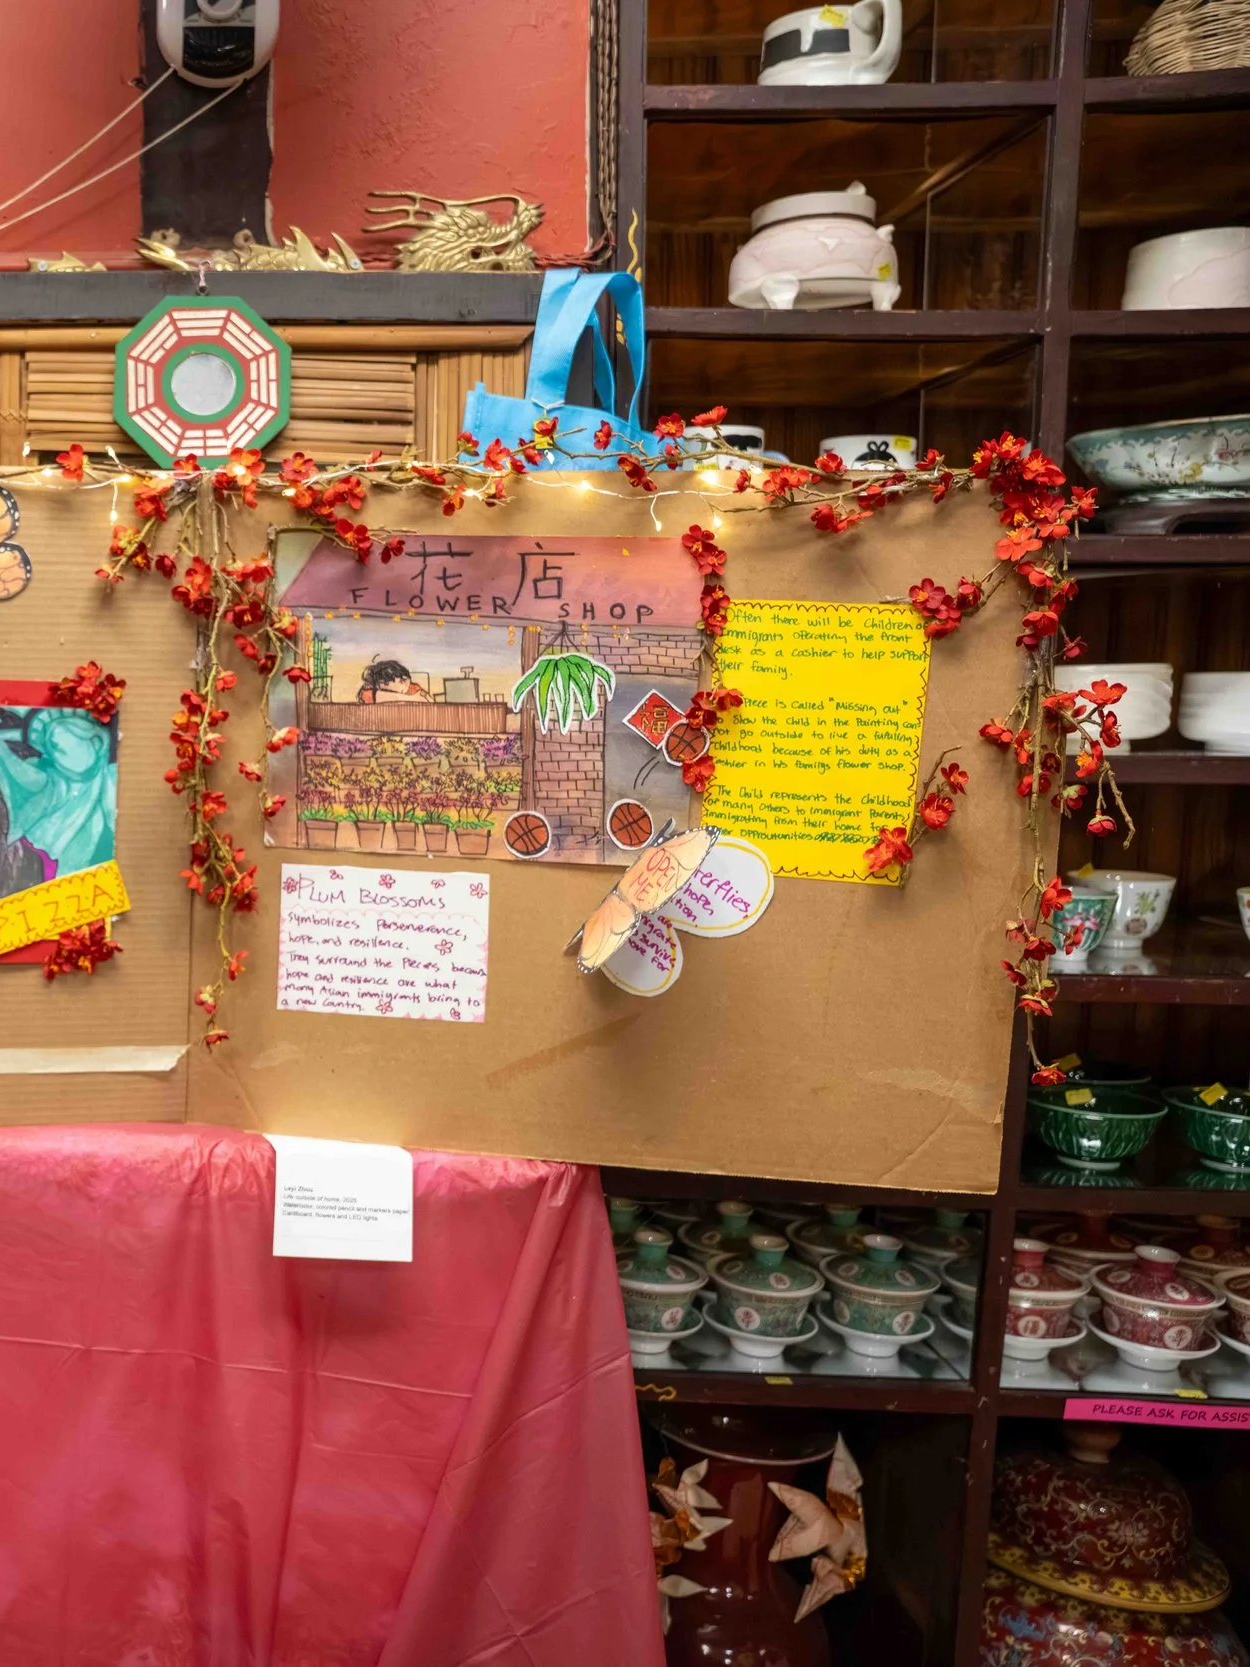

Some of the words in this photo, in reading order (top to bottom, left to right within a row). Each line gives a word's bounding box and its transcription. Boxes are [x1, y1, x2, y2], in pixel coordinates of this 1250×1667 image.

[405, 541, 580, 606] 花店
[349, 587, 514, 615] FLOWER
[558, 602, 654, 623] SHOP
[725, 607, 762, 623] Often
[807, 617, 830, 626] will
[838, 616, 852, 628] be
[855, 632, 874, 641] the
[843, 649, 854, 658] to
[862, 648, 885, 660] help
[775, 699, 786, 709] is
[762, 716, 777, 725] the
[834, 718, 849, 726] the
[740, 729, 754, 739] go
[812, 731, 824, 739] to
[772, 742, 812, 756] because
[820, 747, 831, 755] of
[835, 746, 850, 755] his
[859, 744, 880, 757] duty
[717, 785, 731, 796] The
[834, 793, 852, 804] the
[722, 800, 753, 814] many
[797, 806, 805, 815] to
[834, 820, 861, 831] home
[322, 937, 342, 947] and
[374, 957, 393, 968] the
[286, 968, 309, 980] hope
[315, 974, 333, 983] and
[398, 979, 416, 987] are
[425, 979, 456, 989] what
[468, 997, 480, 1006] to
[1093, 1404, 1143, 1416] PLEASE
[1148, 1408, 1175, 1418] ASK
[1180, 1410, 1206, 1420] FOR
